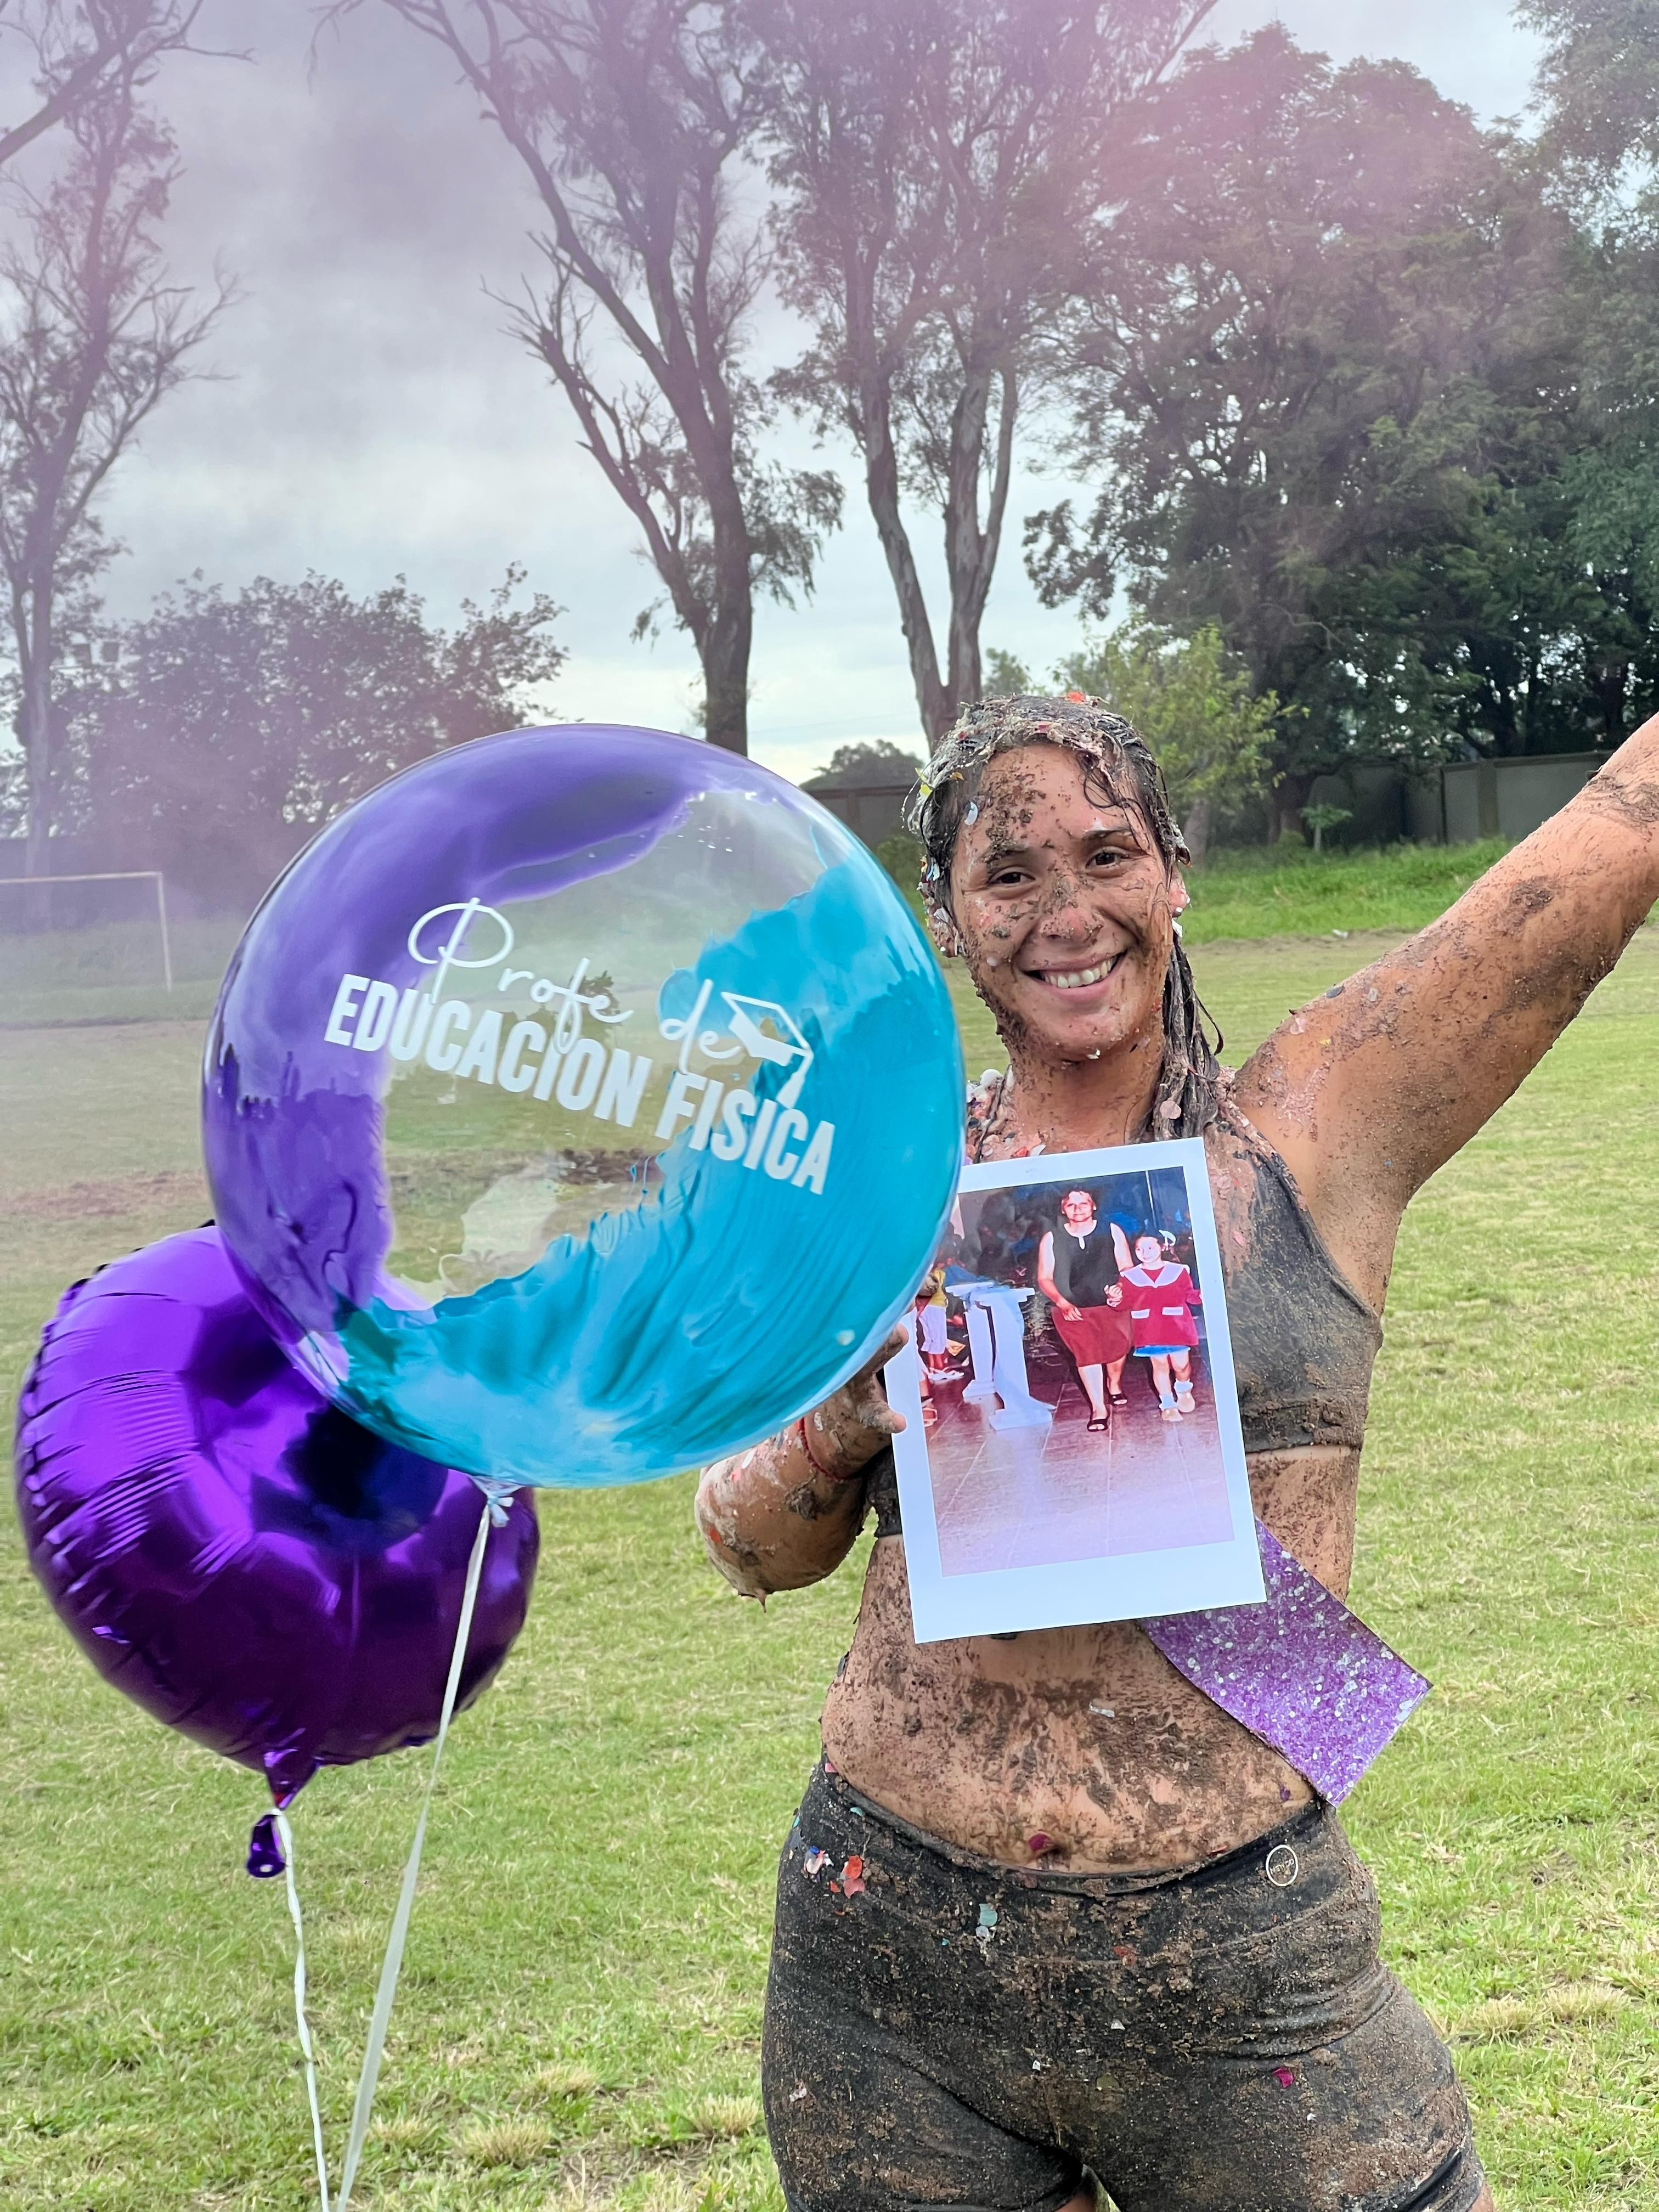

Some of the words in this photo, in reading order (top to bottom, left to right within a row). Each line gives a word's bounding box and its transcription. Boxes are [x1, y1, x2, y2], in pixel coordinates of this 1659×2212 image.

[324, 974, 652, 1127] EDUCACION
[655, 1072, 836, 1194] FISICA
[407, 897, 634, 1054] Profe
[659, 979, 741, 1074] de
